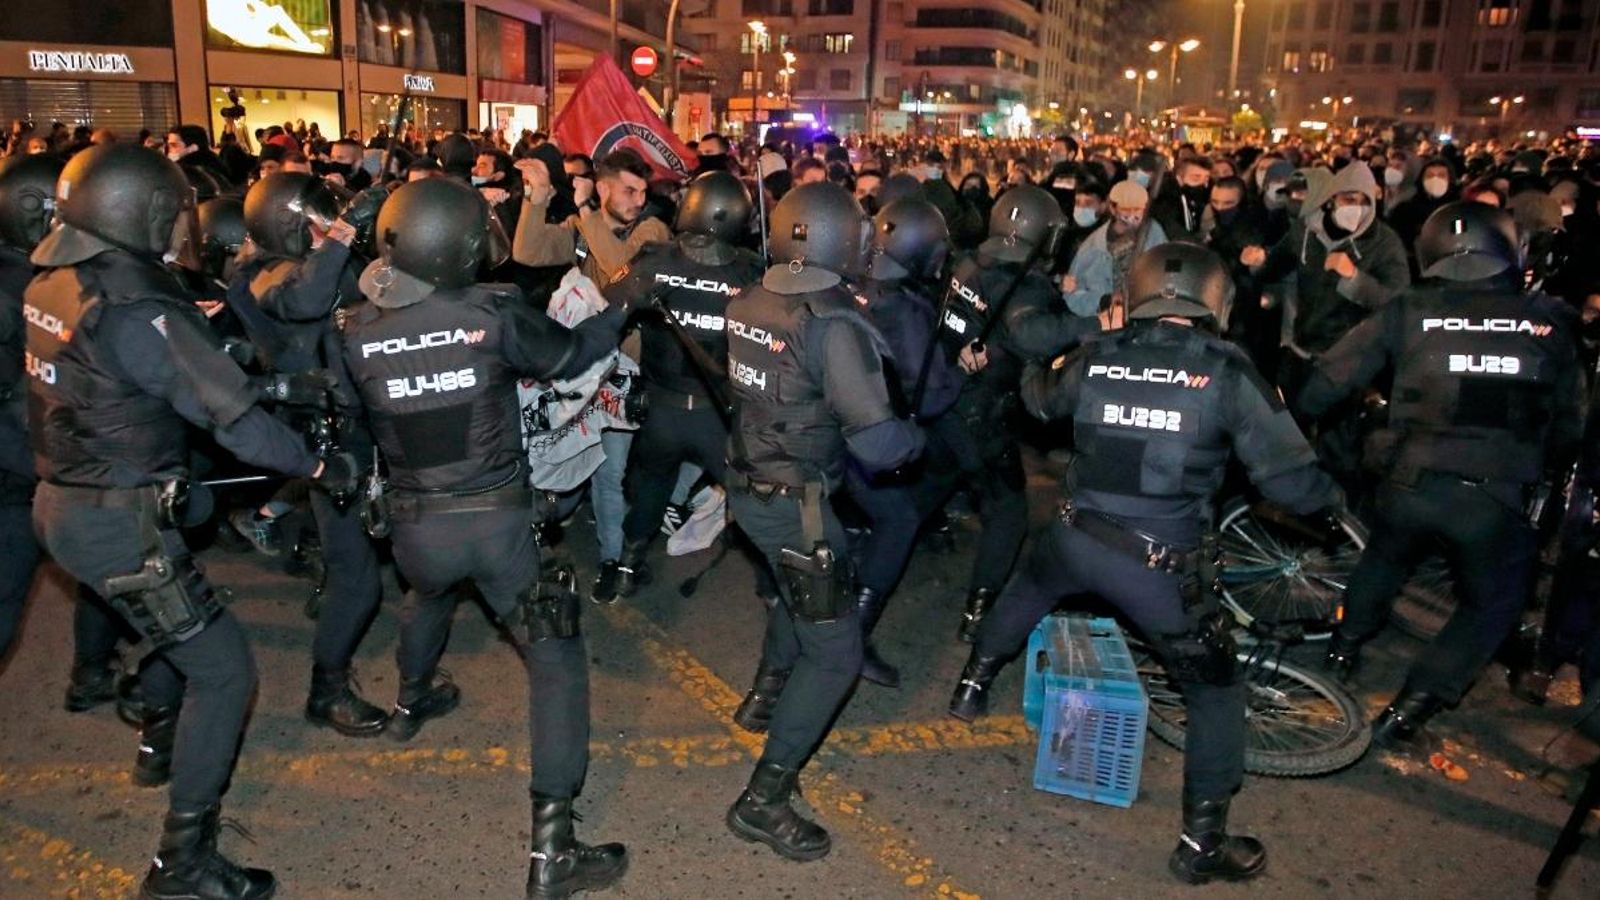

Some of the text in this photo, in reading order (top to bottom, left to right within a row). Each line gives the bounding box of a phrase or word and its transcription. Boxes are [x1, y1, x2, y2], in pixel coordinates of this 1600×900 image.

[655, 273, 731, 296] POLICIA
[727, 319, 773, 351] POLICIA
[1423, 318, 1535, 335] POLICIA
[361, 328, 469, 359] POLICIA
[1088, 365, 1190, 388] POLICIA
